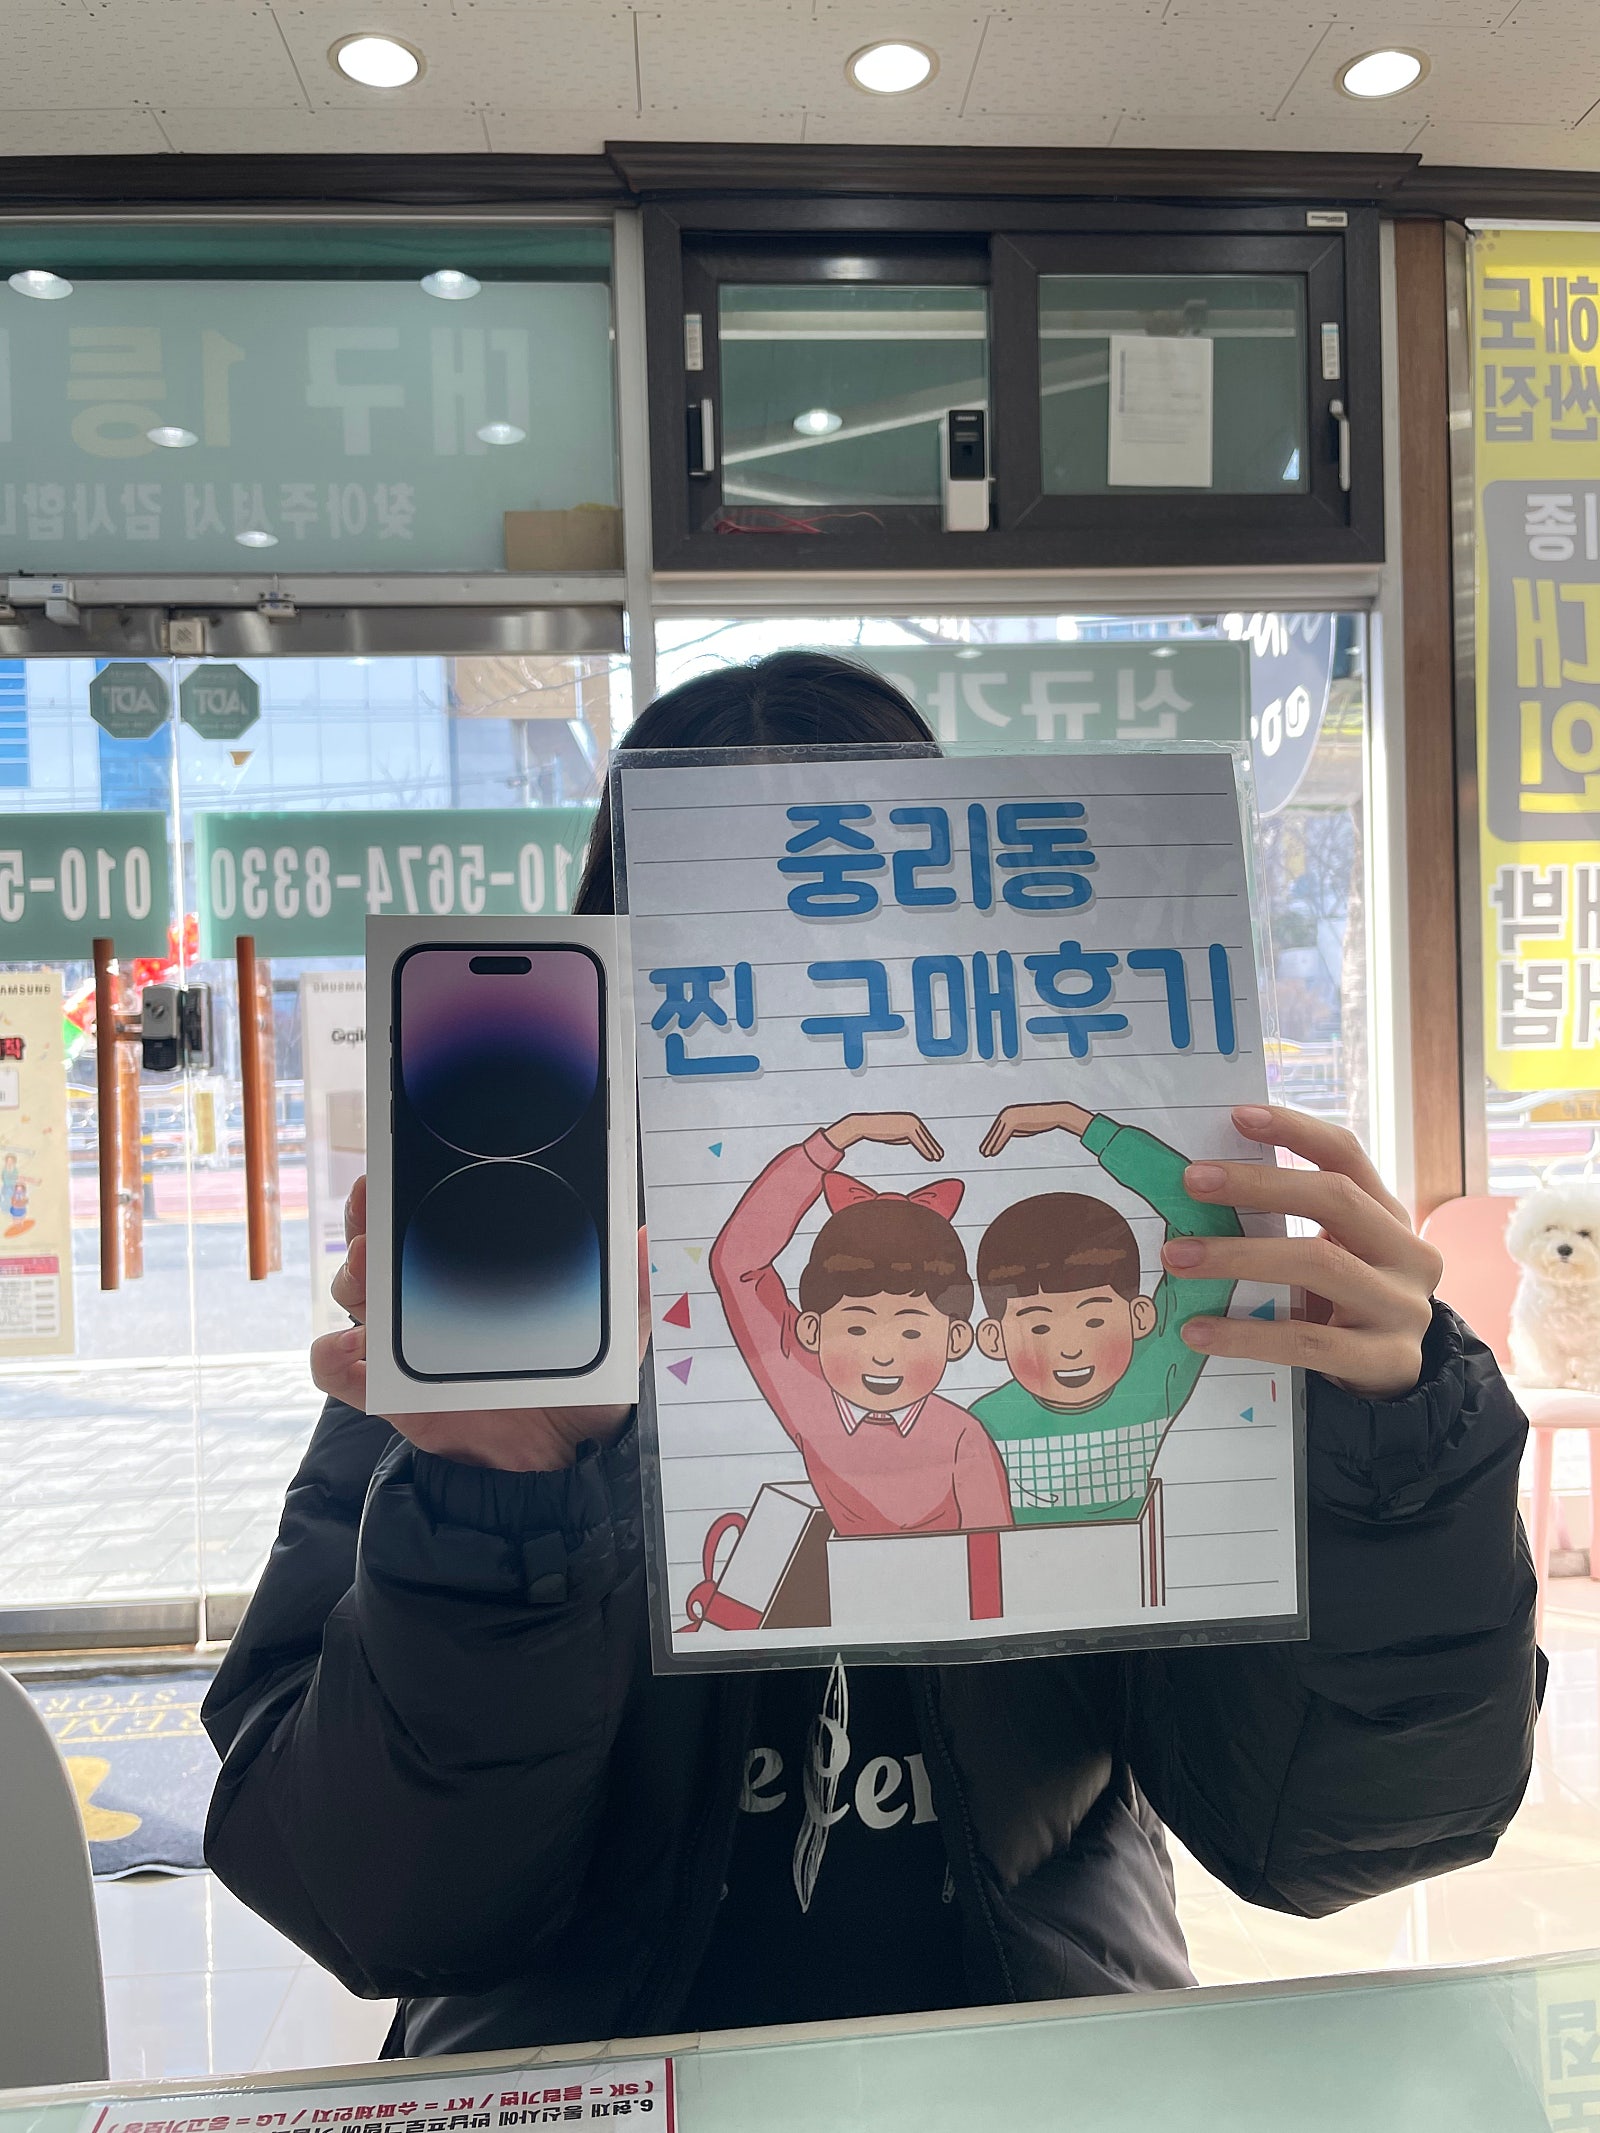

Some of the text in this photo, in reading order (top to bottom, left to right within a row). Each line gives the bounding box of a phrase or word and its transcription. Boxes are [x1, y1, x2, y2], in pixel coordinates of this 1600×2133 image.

[777, 801, 1096, 918] 중리동
[649, 939, 1240, 1077] 찐 구매후기
[609, 2083, 639, 2097] SK
[311, 2101, 419, 2123] 슈퍼체인지
[443, 2097, 475, 2111] KT
[591, 2099, 654, 2118] 6.현재
[255, 2112, 287, 2127] LG
[498, 2104, 583, 2125] 통신사에
